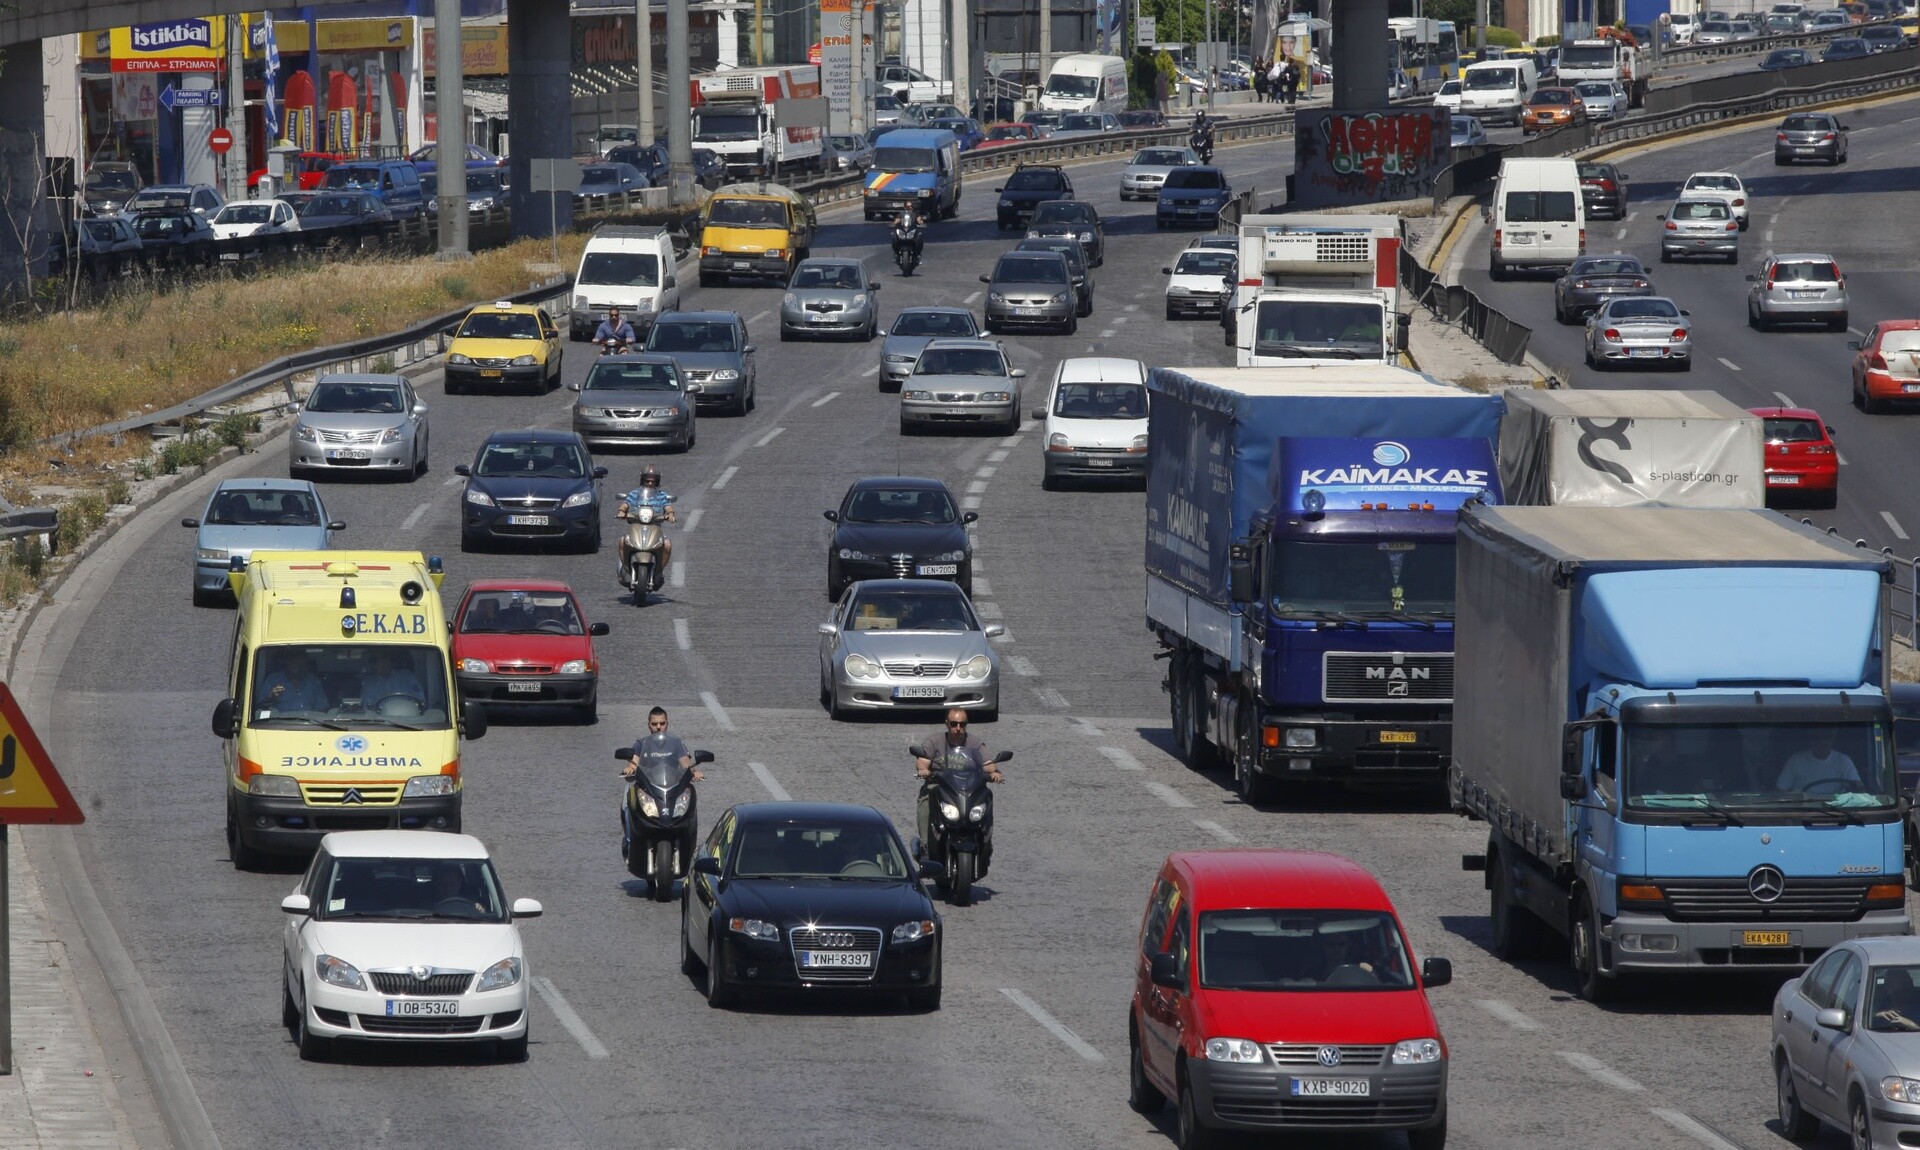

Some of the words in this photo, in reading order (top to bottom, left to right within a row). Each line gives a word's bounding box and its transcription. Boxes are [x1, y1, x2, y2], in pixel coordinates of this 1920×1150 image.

[127, 61, 160, 69] ΕΠΙΠΛΑ
[169, 60, 216, 69] ΣΤΡΩΜΑΤΑ
[210, 91, 219, 103] P
[1300, 464, 1488, 486] ΚΑΪΜΑΚΑΣ
[1650, 470, 1739, 487] s-plasticon.gr
[1360, 484, 1407, 492] ΓΕΝΙΚΕΣ
[1365, 667, 1430, 679] MAN
[813, 953, 870, 966] YNH-8397
[398, 1002, 457, 1015] IOB-5340
[1303, 1080, 1368, 1094] KXB-9020
